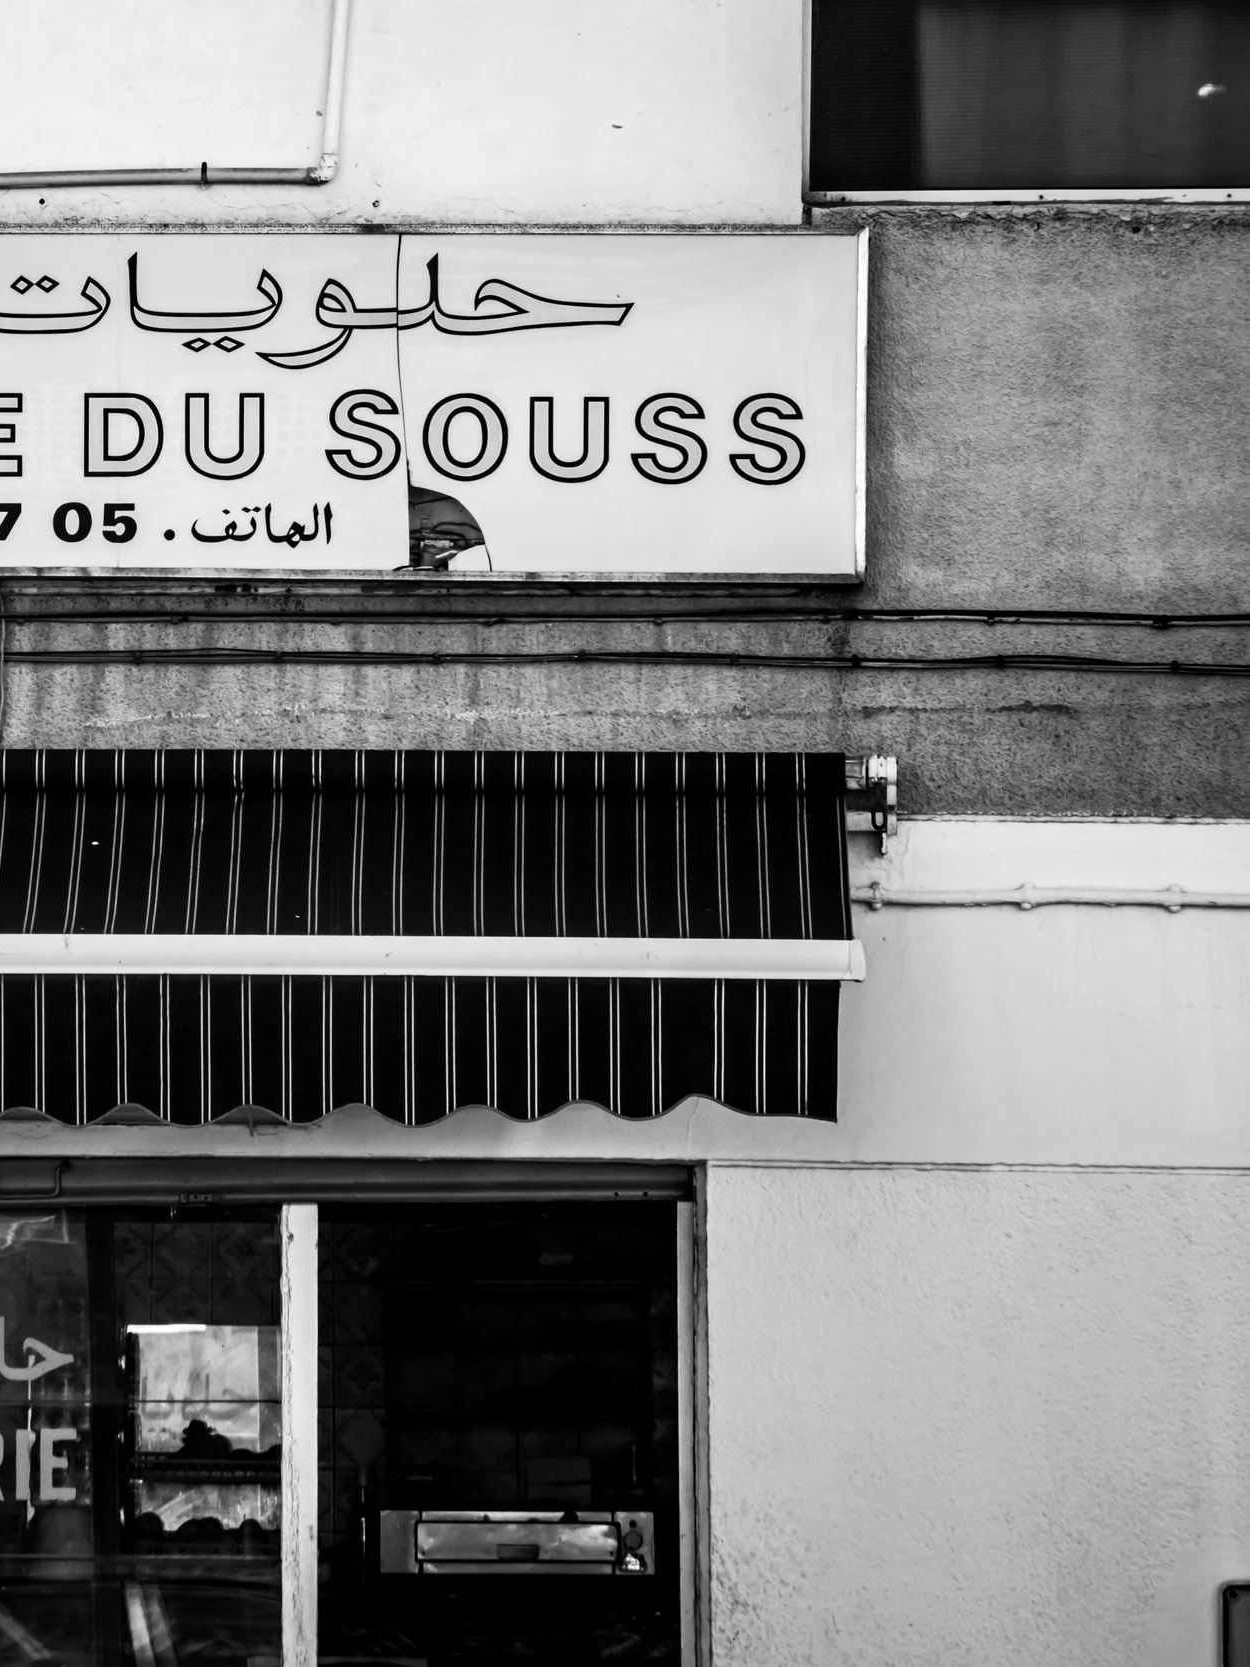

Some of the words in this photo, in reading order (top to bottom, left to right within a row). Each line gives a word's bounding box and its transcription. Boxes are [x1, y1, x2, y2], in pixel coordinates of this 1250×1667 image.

[84, 393, 264, 481] DU
[325, 389, 806, 486] SOUSS
[53, 502, 137, 543] 05
